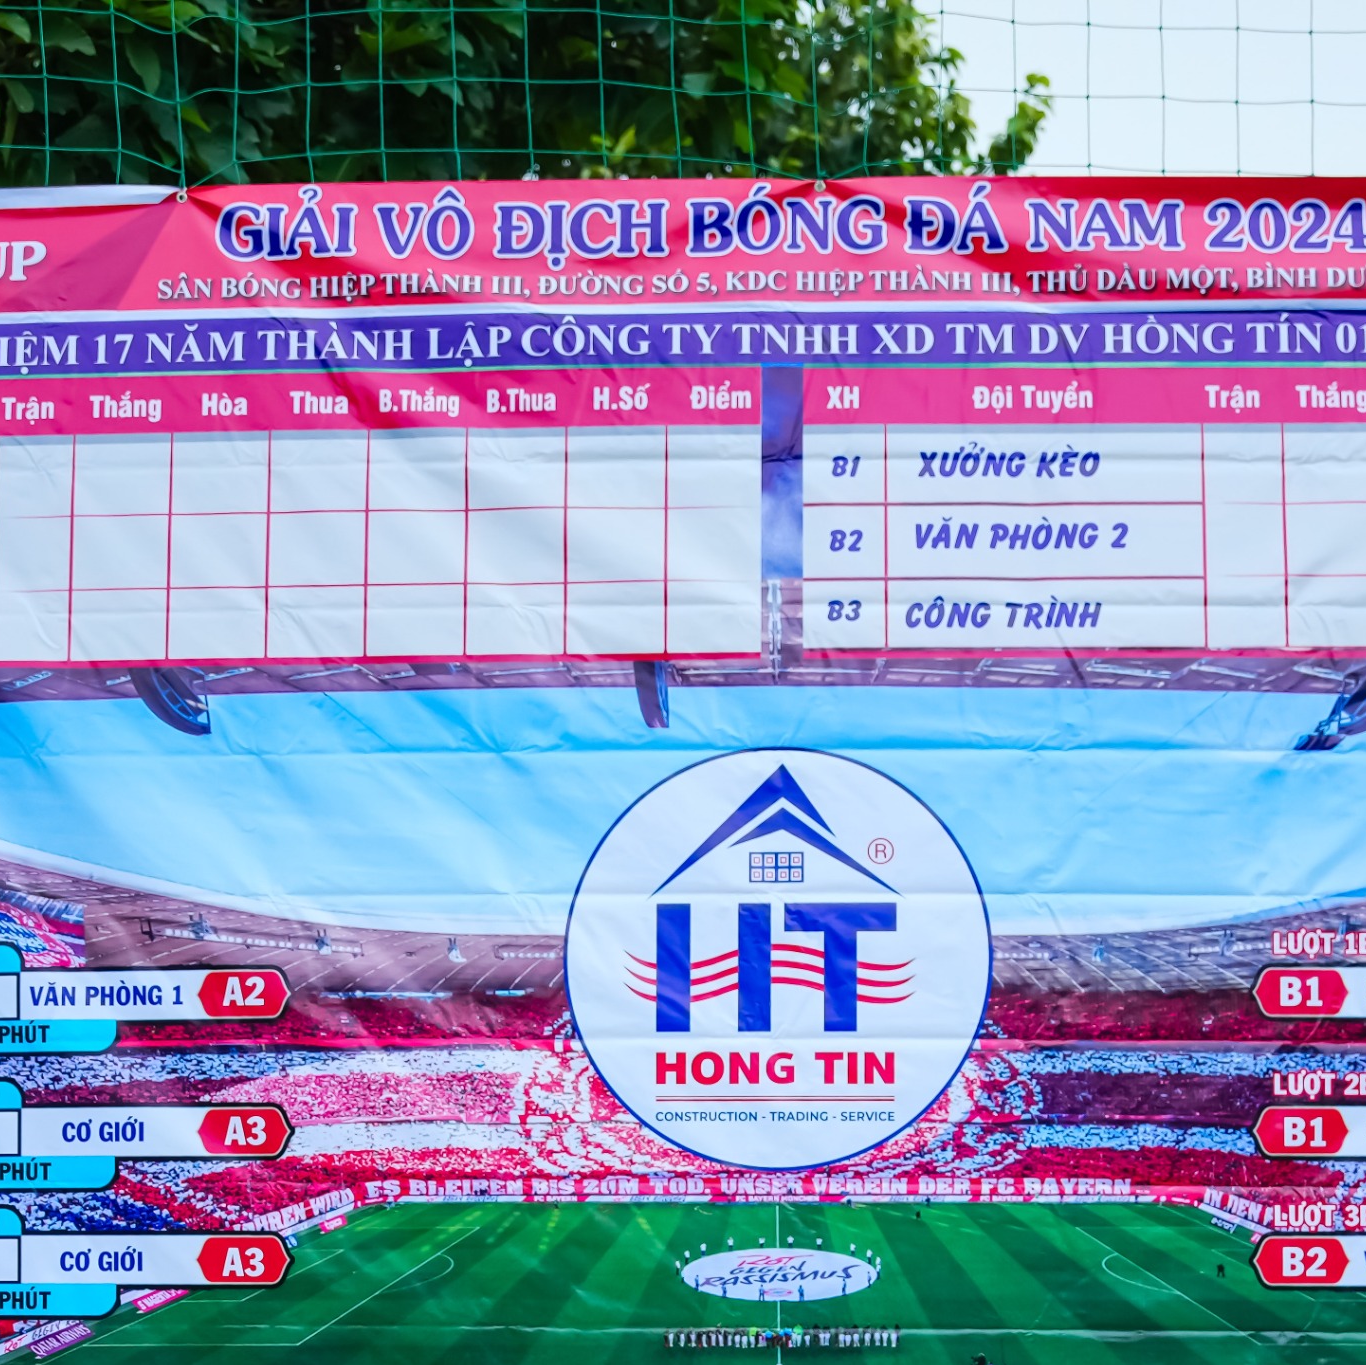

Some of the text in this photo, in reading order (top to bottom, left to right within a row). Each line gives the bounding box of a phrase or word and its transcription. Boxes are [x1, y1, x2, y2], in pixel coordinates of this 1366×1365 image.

[215, 185, 356, 261] GIẢI
[376, 187, 475, 260] VÔ
[492, 198, 670, 271] ĐỊCH
[686, 182, 887, 259] BÓNG
[903, 180, 1008, 257] ĐÁ
[1025, 196, 1186, 256] NAM
[157, 272, 214, 300] SÂN
[222, 270, 301, 299] BÓNG
[309, 272, 377, 305] HIỆP
[381, 267, 483, 296] THÀNH
[490, 273, 531, 300] III,
[537, 266, 645, 296] ĐƯỜNG
[651, 266, 690, 294] SỐ
[695, 272, 718, 297] 5,
[726, 270, 788, 293] KDC
[795, 268, 864, 297] HIỆP
[870, 265, 974, 293] THÀNH
[979, 270, 1021, 297] III,
[1026, 263, 1088, 294] THỦ
[1096, 262, 1160, 293] DẦU
[1164, 262, 1240, 297] MỘT,
[1245, 262, 1318, 289] BÌNH
[94, 332, 133, 365] 17
[144, 324, 245, 363] NĂM
[258, 321, 412, 362] THÀNH
[427, 320, 513, 368] LẬP
[521, 314, 652, 358] CÔNG
[662, 323, 721, 356] TY
[731, 322, 859, 356] TNHH
[873, 322, 934, 355] XD
[945, 321, 1015, 355] TM
[1028, 321, 1090, 355] DV
[1102, 312, 1234, 356] HỒNG
[1245, 313, 1324, 355] TÍN
[2, 396, 55, 424] Trận
[90, 388, 163, 423] Thắng
[201, 392, 248, 417] Hòa
[290, 391, 348, 415] Thua
[378, 383, 460, 418] B.Thắng
[486, 388, 557, 413] B.Thua
[593, 383, 649, 412] H.Số
[689, 381, 752, 411] Điểm
[831, 456, 861, 478] B1
[918, 441, 1101, 478] XƯỞNG KÈO
[29, 978, 183, 1007] VĂN PHÒNG 1
[222, 977, 265, 1008] A2
[655, 1051, 894, 1085] HONG TIN
[655, 1111, 894, 1122] CONSTRUCTION TRADING SERVICE
[721, 1177, 803, 1195] UNSER
[812, 1177, 907, 1194] VEREIN
[918, 1177, 970, 1194] DER
[981, 1178, 1015, 1194] FC
[1274, 1201, 1336, 1231] LƯỢT
[700, 1265, 861, 1286] RASSISMUS
[730, 1261, 806, 1274] GEGEN
